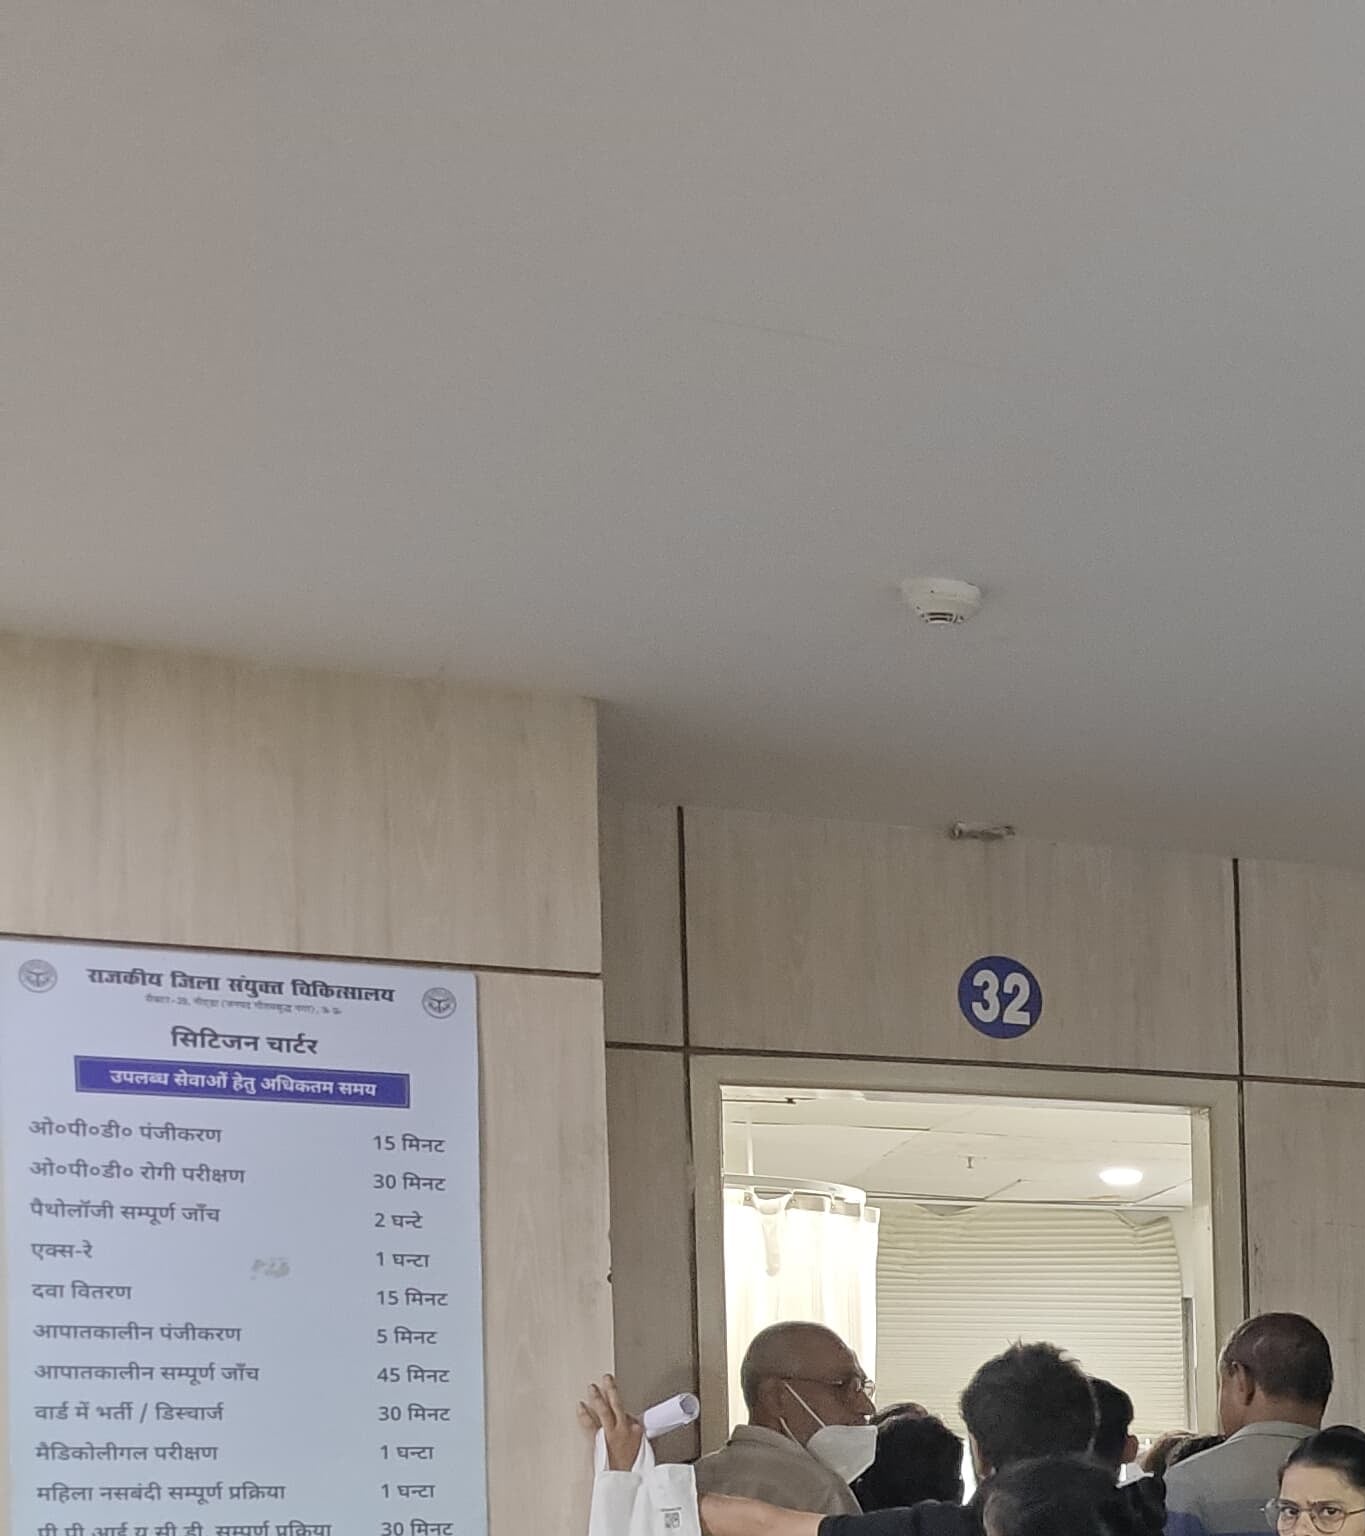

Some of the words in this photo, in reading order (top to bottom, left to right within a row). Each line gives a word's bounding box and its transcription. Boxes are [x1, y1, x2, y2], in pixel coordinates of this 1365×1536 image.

[86, 968, 163, 987] राजकीय
[170, 971, 220, 991] जिला
[227, 975, 284, 998] संयुक्त
[291, 979, 396, 1002] चिकित्सालय
[972, 969, 1031, 1026] 32
[170, 1025, 259, 1051] सिटिजन
[266, 1031, 318, 1055] चार्टर
[110, 1068, 169, 1088] उपलब्ध
[174, 1067, 228, 1091] सेवाओं
[231, 1072, 257, 1095] हेतु
[261, 1074, 334, 1095] अधिकतम
[338, 1080, 376, 1097] समय
[140, 1119, 222, 1144] पंजीकरण
[374, 1136, 395, 1152] 15
[402, 1134, 446, 1154] मिनट
[141, 1159, 175, 1182] रोगी
[182, 1162, 245, 1184] परीक्षण
[374, 1174, 396, 1190] 30
[402, 1173, 446, 1192] मिनट
[30, 1198, 114, 1221] पैथोलॉजी
[120, 1201, 175, 1226] सम्पूर्ण
[182, 1203, 220, 1224] जाँच
[375, 1213, 386, 1229] 2
[31, 1240, 93, 1261] एक्स-रे
[376, 1252, 384, 1267] 1
[32, 1283, 64, 1300] दवा
[71, 1280, 132, 1300] वितरण
[377, 1291, 398, 1306] 15
[404, 1288, 448, 1307] मिनट
[33, 1323, 153, 1342] आपातकालीन
[160, 1323, 241, 1343] पंजीकरण
[377, 1329, 388, 1344] 5
[394, 1327, 438, 1345] मिनट
[34, 1362, 154, 1381] आपातकालीन
[161, 1363, 216, 1386] सम्पूर्ण
[221, 1362, 260, 1382] जाँच
[377, 1368, 400, 1383] 45
[406, 1366, 450, 1384] मिनट
[35, 1401, 68, 1420] वार्ड
[75, 1401, 89, 1420] में
[96, 1401, 134, 1420] भर्ती
[155, 1402, 224, 1421] डिस्चार्ज
[378, 1406, 401, 1422] 30
[407, 1405, 450, 1423] मिनट
[35, 1441, 148, 1461] मैडिकोलीगल
[155, 1443, 217, 1461] परीक्षण
[381, 1445, 389, 1460] 1
[37, 1482, 93, 1501] महिला
[100, 1483, 161, 1501] नसबंदी
[168, 1482, 222, 1505] सम्पूर्ण
[229, 1484, 285, 1500] प्रक्रिया
[382, 1484, 389, 1498] 1
